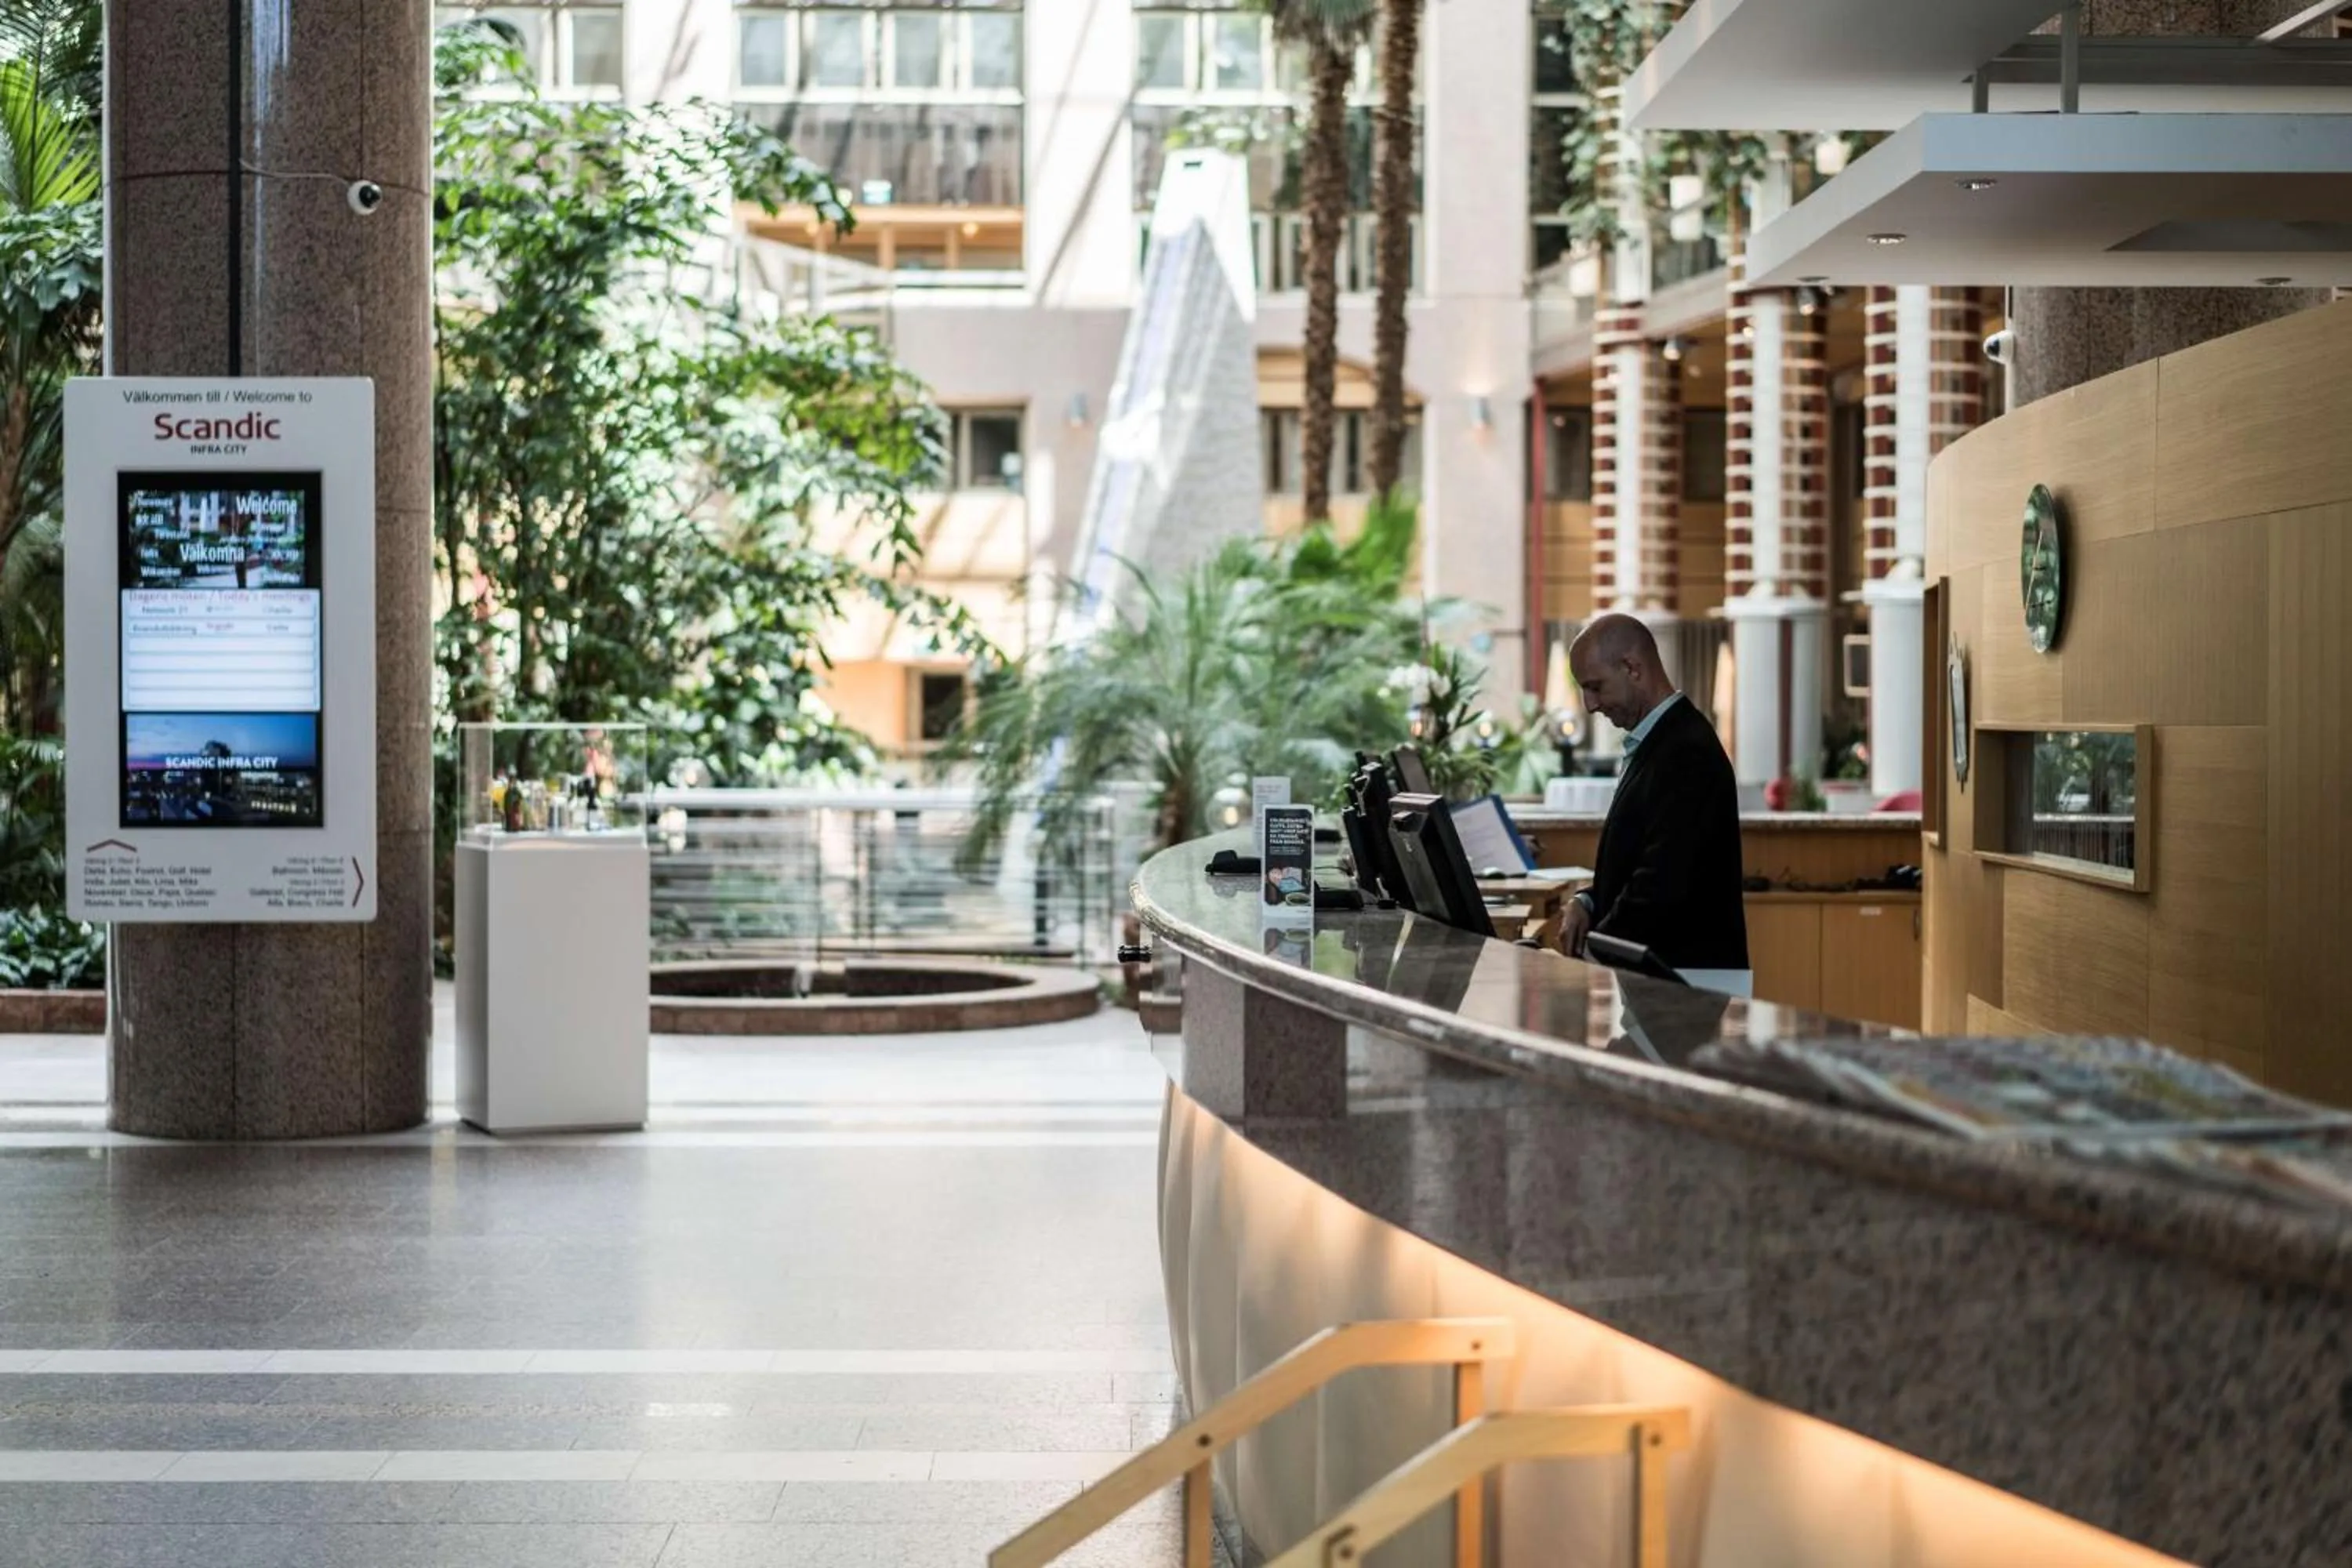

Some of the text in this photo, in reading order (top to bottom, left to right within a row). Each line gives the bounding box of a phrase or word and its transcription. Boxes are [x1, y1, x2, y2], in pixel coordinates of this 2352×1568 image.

[123, 390, 202, 403] Välkommen
[207, 390, 220, 403] till
[234, 390, 295, 403] Welcome
[299, 391, 313, 403] to
[154, 412, 281, 441] Scandic
[191, 445, 247, 455] INFRA CITY
[236, 495, 298, 515] Welcome
[165, 757, 278, 769] SCANDIC INFRA CITY
